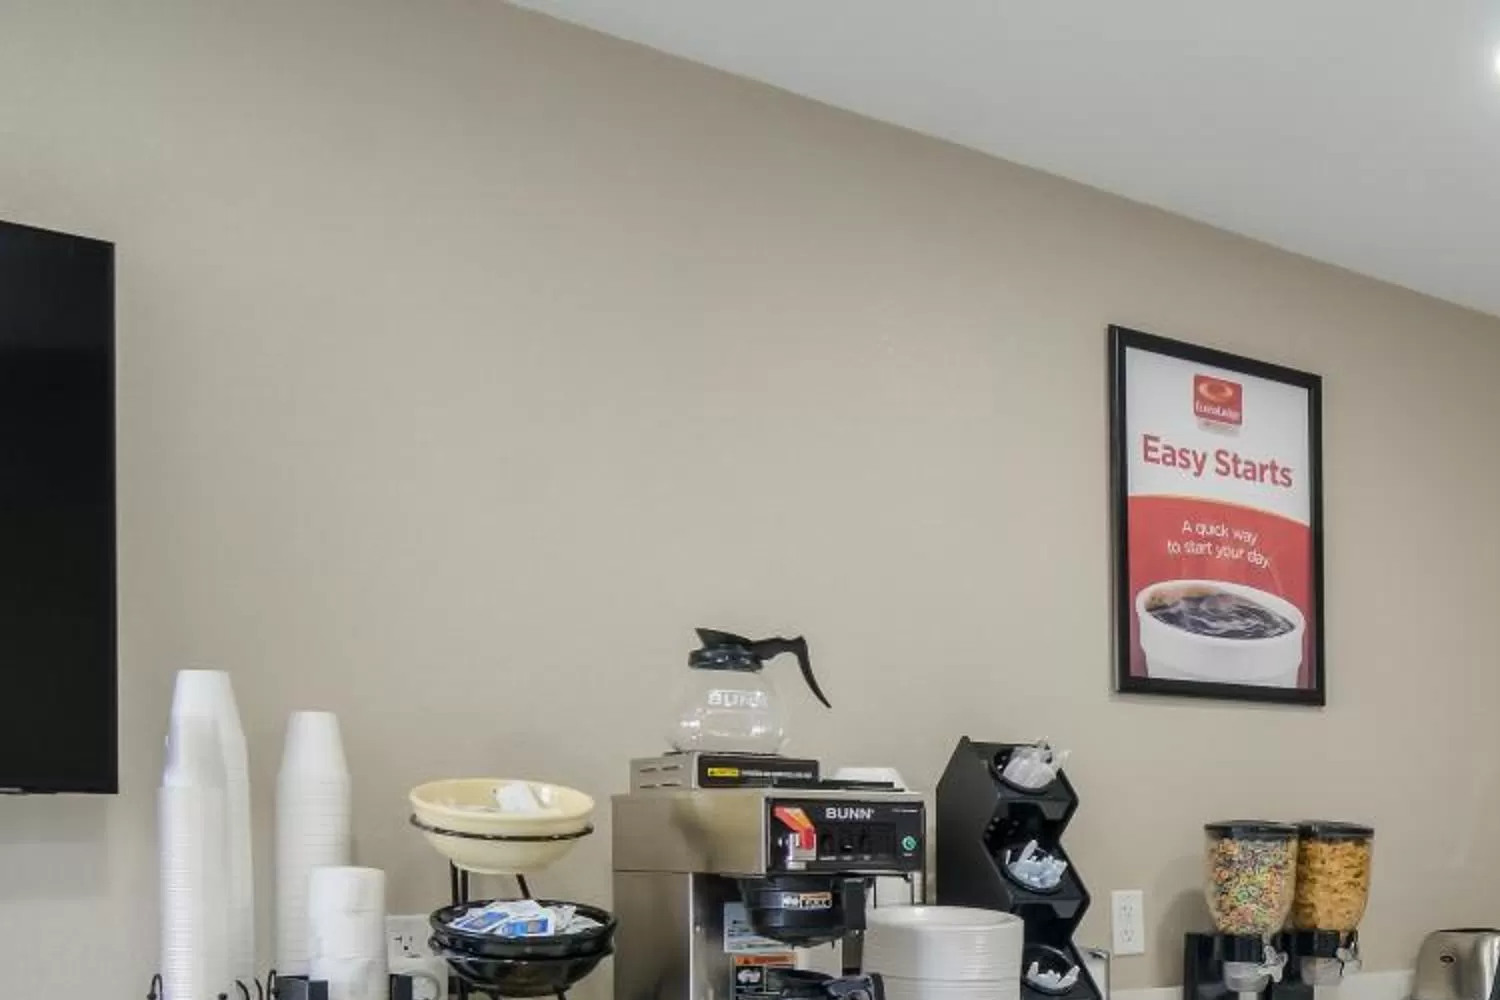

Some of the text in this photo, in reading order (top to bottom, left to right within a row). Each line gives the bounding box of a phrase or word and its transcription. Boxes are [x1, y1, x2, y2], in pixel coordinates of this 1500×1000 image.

[1143, 433, 1293, 488] Easy Starts
[1182, 520, 1258, 546] A quick way
[1167, 540, 1181, 555] to
[1184, 539, 1212, 556] start
[1215, 545, 1244, 560] your
[825, 807, 872, 820] BUNN
